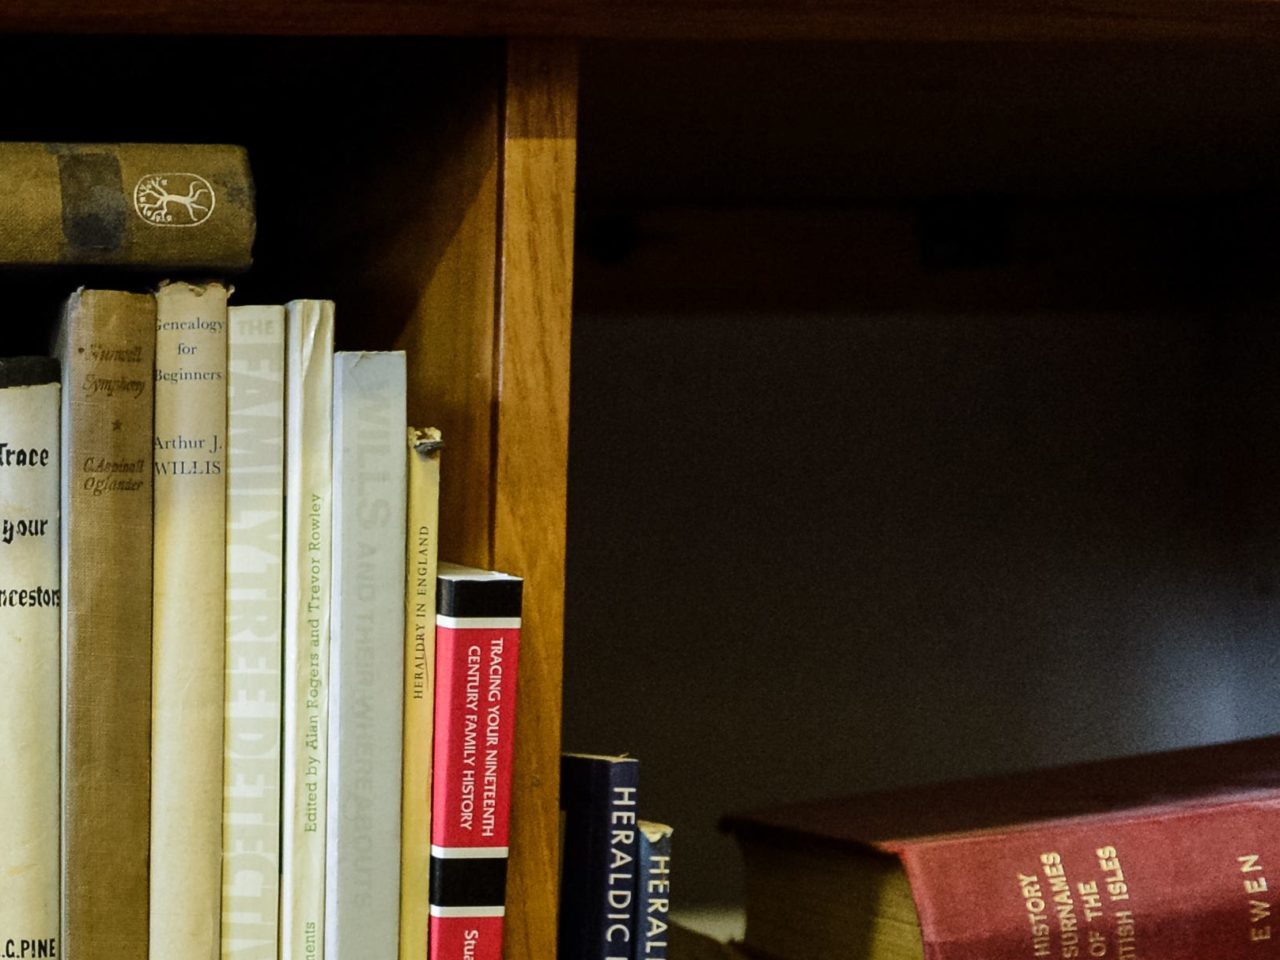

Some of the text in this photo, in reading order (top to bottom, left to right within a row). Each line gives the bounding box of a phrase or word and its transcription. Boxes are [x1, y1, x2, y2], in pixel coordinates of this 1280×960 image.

[177, 342, 197, 356] for
[154, 460, 221, 476] WILLIS
[2, 518, 48, 544] your
[414, 525, 429, 699] HERALDRY IN ENGLAND
[460, 645, 481, 831] CENTURY FAMILY HISTORY
[482, 638, 503, 837] TRACING YOUR NINETEENTH
[604, 785, 638, 945] HERALDIC
[1040, 851, 1079, 958] SURNAMES
[1096, 845, 1129, 901] ISLES
[1017, 874, 1051, 956] HISTORY
[1077, 880, 1107, 957] OF THE
